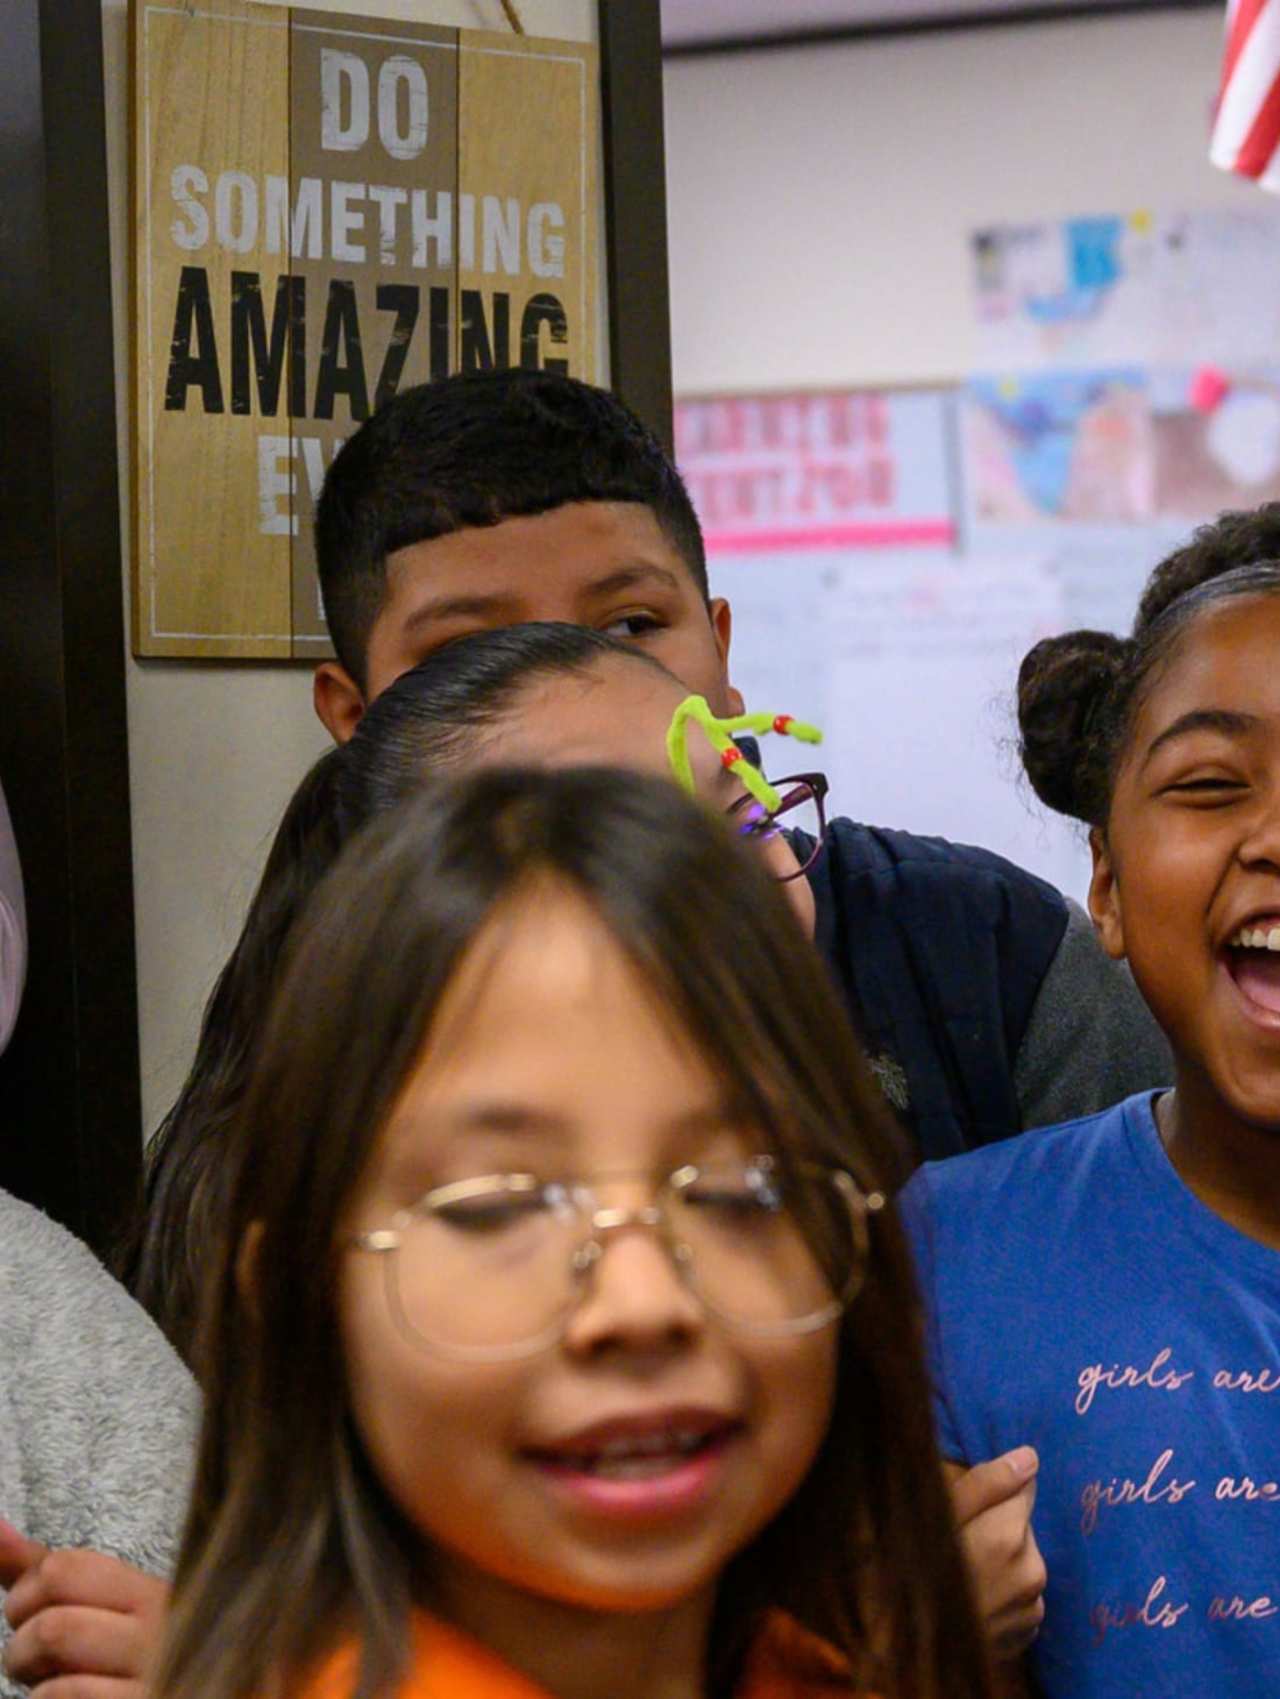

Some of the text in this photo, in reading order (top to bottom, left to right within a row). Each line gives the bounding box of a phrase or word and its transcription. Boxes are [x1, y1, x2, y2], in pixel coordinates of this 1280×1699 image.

[320, 47, 430, 161] DO
[169, 163, 566, 279] SOMETHING
[163, 265, 569, 422] AMAZING
[1074, 1347, 1195, 1416] girls
[1079, 1448, 1196, 1537] girls
[1207, 1595, 1280, 1621] are
